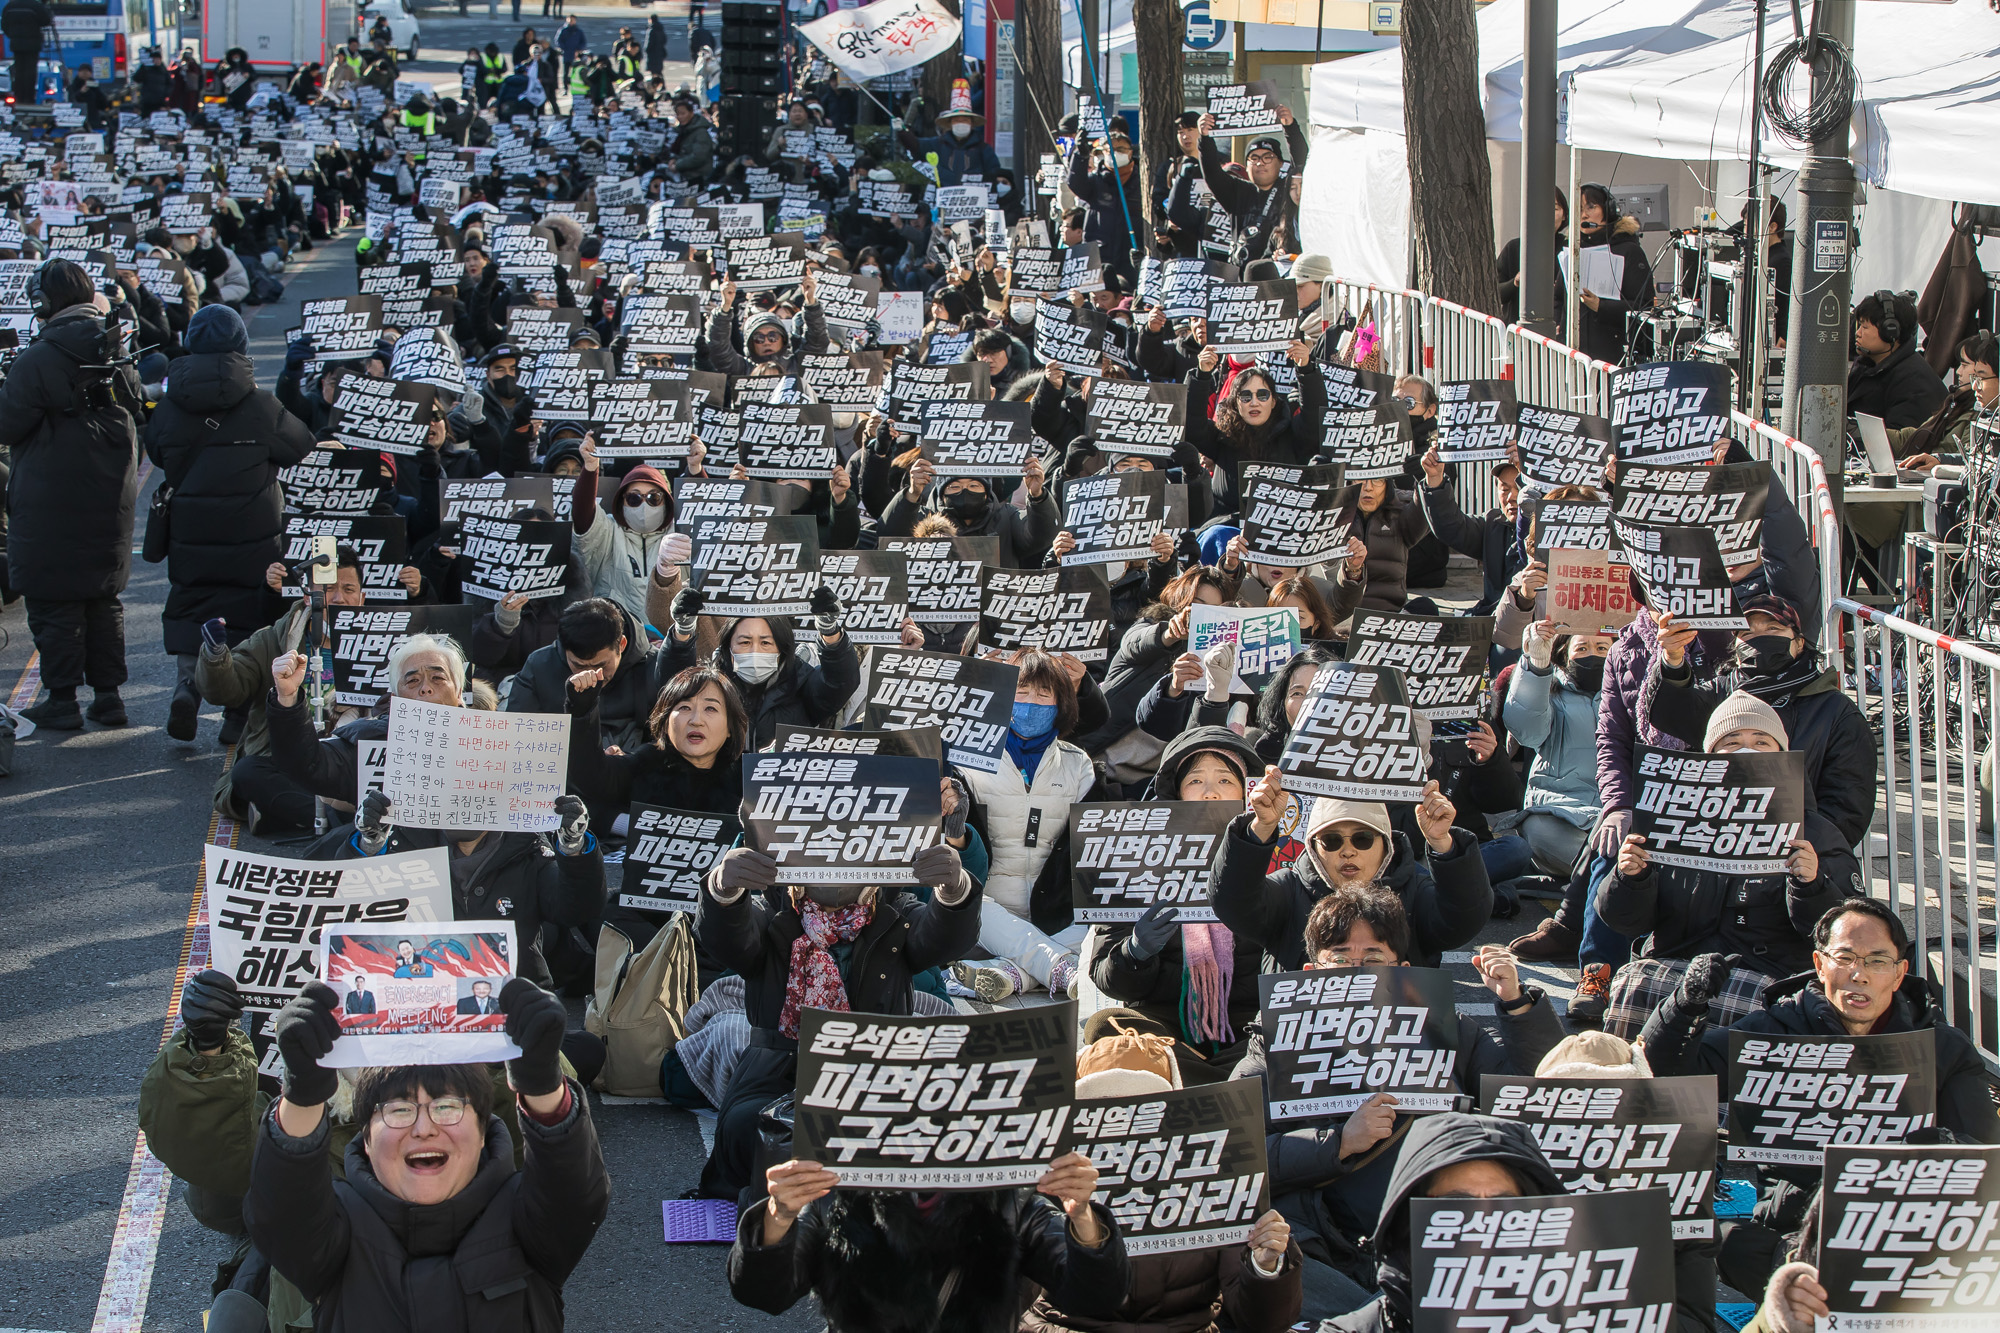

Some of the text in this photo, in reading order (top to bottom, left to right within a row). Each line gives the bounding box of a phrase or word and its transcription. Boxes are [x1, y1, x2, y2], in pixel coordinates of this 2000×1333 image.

[1209, 95, 1266, 113] 파면하고
[1216, 109, 1276, 128] 구속하라!
[728, 237, 771, 250] 윤석열을
[728, 246, 792, 264] 파면하고
[737, 260, 805, 279] 구속하라!
[1209, 285, 1259, 300] 윤석열을
[303, 300, 347, 315] 윤석열을
[623, 310, 690, 326] 파면하고
[1209, 299, 1284, 321] 파면하고
[303, 313, 370, 334] 파면하고
[1215, 318, 1297, 343] 구속하라!
[1817, 331, 1838, 343] 종로
[338, 374, 396, 397] 윤석열을
[894, 365, 948, 382] 윤석열을
[1612, 367, 1670, 395] 윤석열을
[334, 391, 419, 422] 파면하고
[924, 404, 986, 417] 윤석열을
[1323, 410, 1377, 426] 윤석열을
[1611, 388, 1705, 426] 파면하고
[338, 414, 429, 444] 구속하라!
[924, 420, 1014, 441] 파면하고
[1323, 421, 1400, 446] 파면하고
[1620, 416, 1728, 453] 구속하라!
[934, 442, 1029, 463] 구속하라!
[1518, 427, 1607, 462] 파면하고
[444, 483, 506, 499] 윤석열을
[678, 483, 745, 499] 윤석열을
[1621, 469, 1709, 492] 윤석열을
[285, 486, 379, 509] 구속하라!
[1254, 483, 1318, 507] 윤석열을
[1615, 492, 1745, 524] 파면하고
[1065, 497, 1150, 527] 파면하고
[1541, 505, 1609, 523] 윤석열을
[697, 521, 768, 542] 윤석열을
[1255, 524, 1354, 551] 구속하라!
[462, 537, 553, 566] 파면하고
[693, 543, 801, 571] 파면하고
[471, 560, 566, 591] 구속하라!
[988, 573, 1059, 593] 윤석열을
[1557, 565, 1604, 579] 내란동조
[702, 572, 822, 601] 구속하라!
[1555, 583, 1643, 613] 해체하
[983, 592, 1094, 620] 파면하고
[994, 619, 1106, 647] 구속하라!
[1196, 612, 1290, 645] 내란수괴 즉각
[876, 654, 961, 680] 윤석열을
[1240, 642, 1291, 675] 파면
[870, 678, 994, 718] 파면하고
[397, 703, 564, 732] 윤석열을 체포하라 구속하라
[394, 725, 563, 755] 윤석열을 파면하라 수사하라
[392, 747, 446, 768] 윤석열은
[512, 761, 557, 774] 감옥으로
[751, 759, 859, 782] 윤석열을
[1639, 753, 1729, 784] 윤석열을
[391, 770, 445, 790] 윤석열아
[1283, 778, 1302, 787] 주항공
[1328, 784, 1341, 792] 참사
[1343, 786, 1376, 795] 희생자들의
[1402, 790, 1422, 798] 빕니다
[389, 790, 441, 808] 김건희도
[749, 786, 909, 821] 파면하고
[1636, 780, 1775, 821] 파면하고
[446, 811, 498, 825] 친일파도
[634, 810, 722, 839] 윤석열을
[1080, 808, 1172, 833] 윤석열을
[767, 825, 938, 862] 구속하라!
[1648, 818, 1800, 856] 구속하라!
[1077, 834, 1216, 868] 파면하고
[216, 859, 343, 898] 내란정범
[795, 871, 815, 879] 여객기
[819, 871, 833, 879] 참사
[835, 871, 869, 879] 희생자들의
[871, 871, 892, 879] 명복을
[636, 900, 659, 908] 제주항공
[385, 984, 450, 1004] EMERGENCY
[1270, 975, 1378, 1009] 윤석열을
[387, 1008, 447, 1024] MEETING
[1269, 1004, 1430, 1052] 파면하고
[810, 1022, 970, 1059] 윤석열을
[1737, 1041, 1856, 1069] 윤석열을
[1292, 1047, 1457, 1094] 구속하라!
[802, 1058, 1037, 1112] 파면하고
[1734, 1069, 1908, 1111] 파면하고
[1291, 1098, 1358, 1113] 제주항공 여객기 참사
[1419, 1098, 1439, 1106] 빕니다
[1492, 1086, 1623, 1118] 윤석열을
[1073, 1101, 1166, 1140] 석열을
[825, 1106, 1070, 1163] 구속하라!
[1073, 1129, 1228, 1183] 면하고
[1750, 1151, 1822, 1161] 제주항공 여객기 참사
[864, 1169, 1037, 1182] 여객기 참사 희생자들의 명복을 빕니다
[1834, 1158, 1987, 1195] 윤석열을
[1099, 1173, 1264, 1230] 속하라!
[1143, 1230, 1242, 1249] 희생자들의 명복을 빕니다
[1423, 1206, 1574, 1248] 윤석열을
[1827, 1201, 2000, 1251] 파면하
[1420, 1247, 1638, 1310] 파면하고
